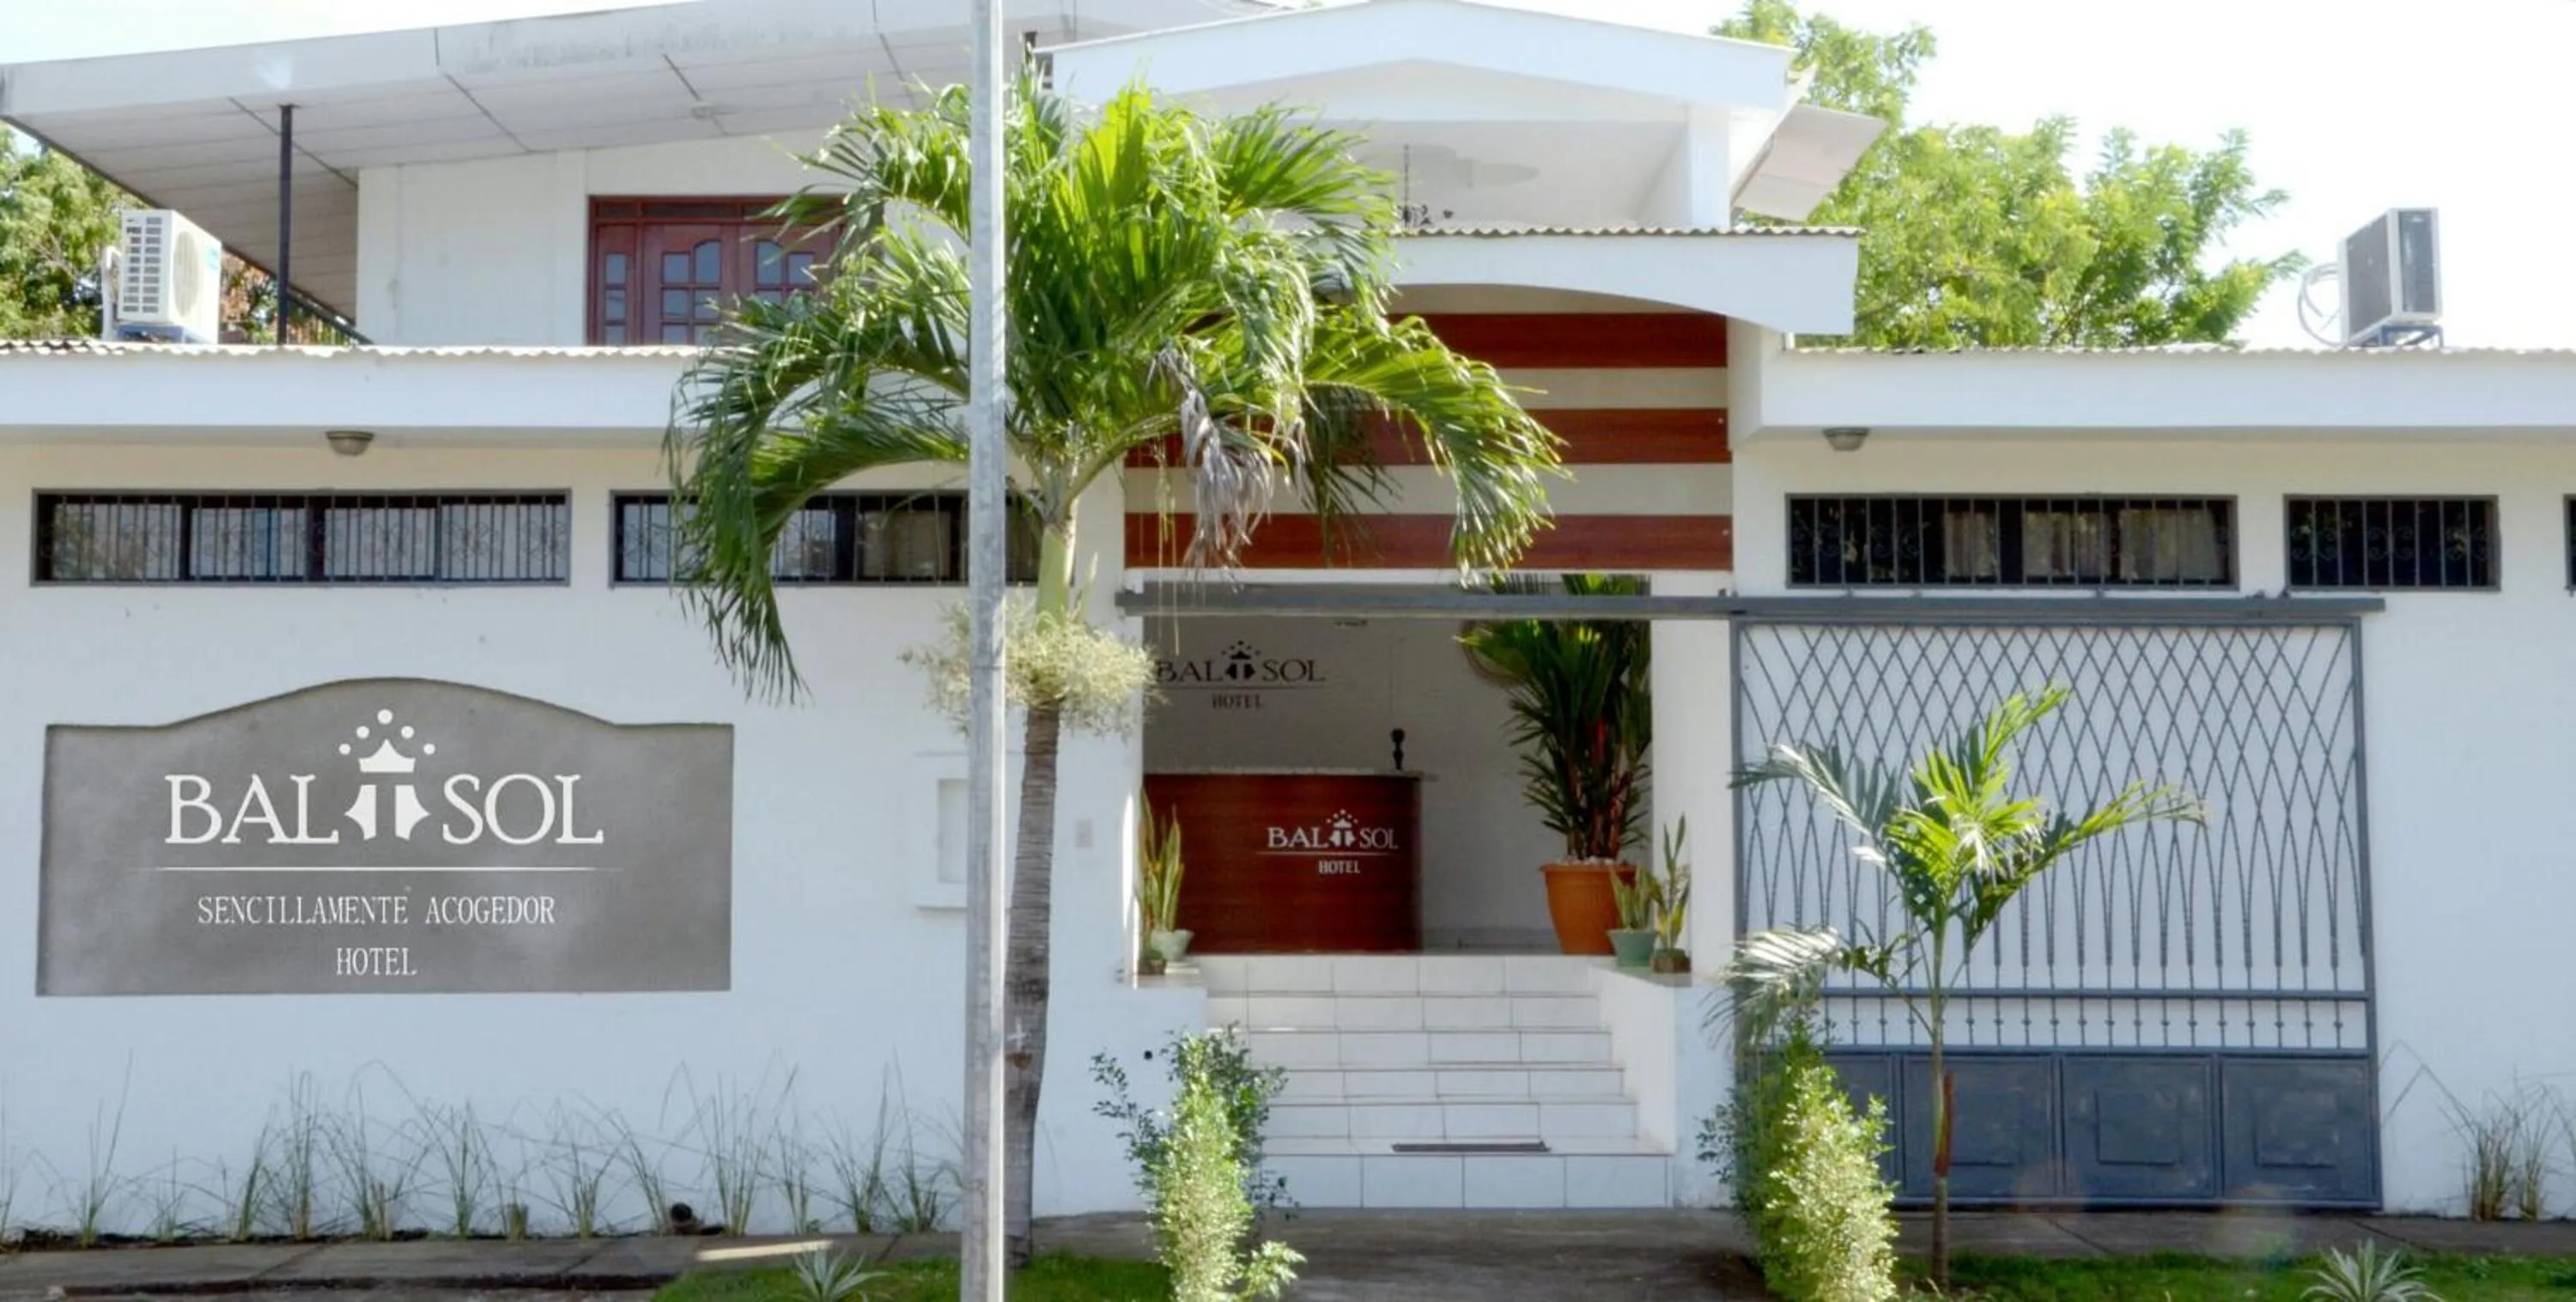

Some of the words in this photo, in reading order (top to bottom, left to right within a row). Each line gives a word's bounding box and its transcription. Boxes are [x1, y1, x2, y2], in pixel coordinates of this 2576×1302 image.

[1212, 692, 1263, 710] HOTEL
[1318, 860, 1361, 874] HOTEL
[197, 895, 410, 925] SENCILLAMENTE
[425, 895, 556, 925] ACOGEDOR
[336, 947, 417, 976] HOTEL
